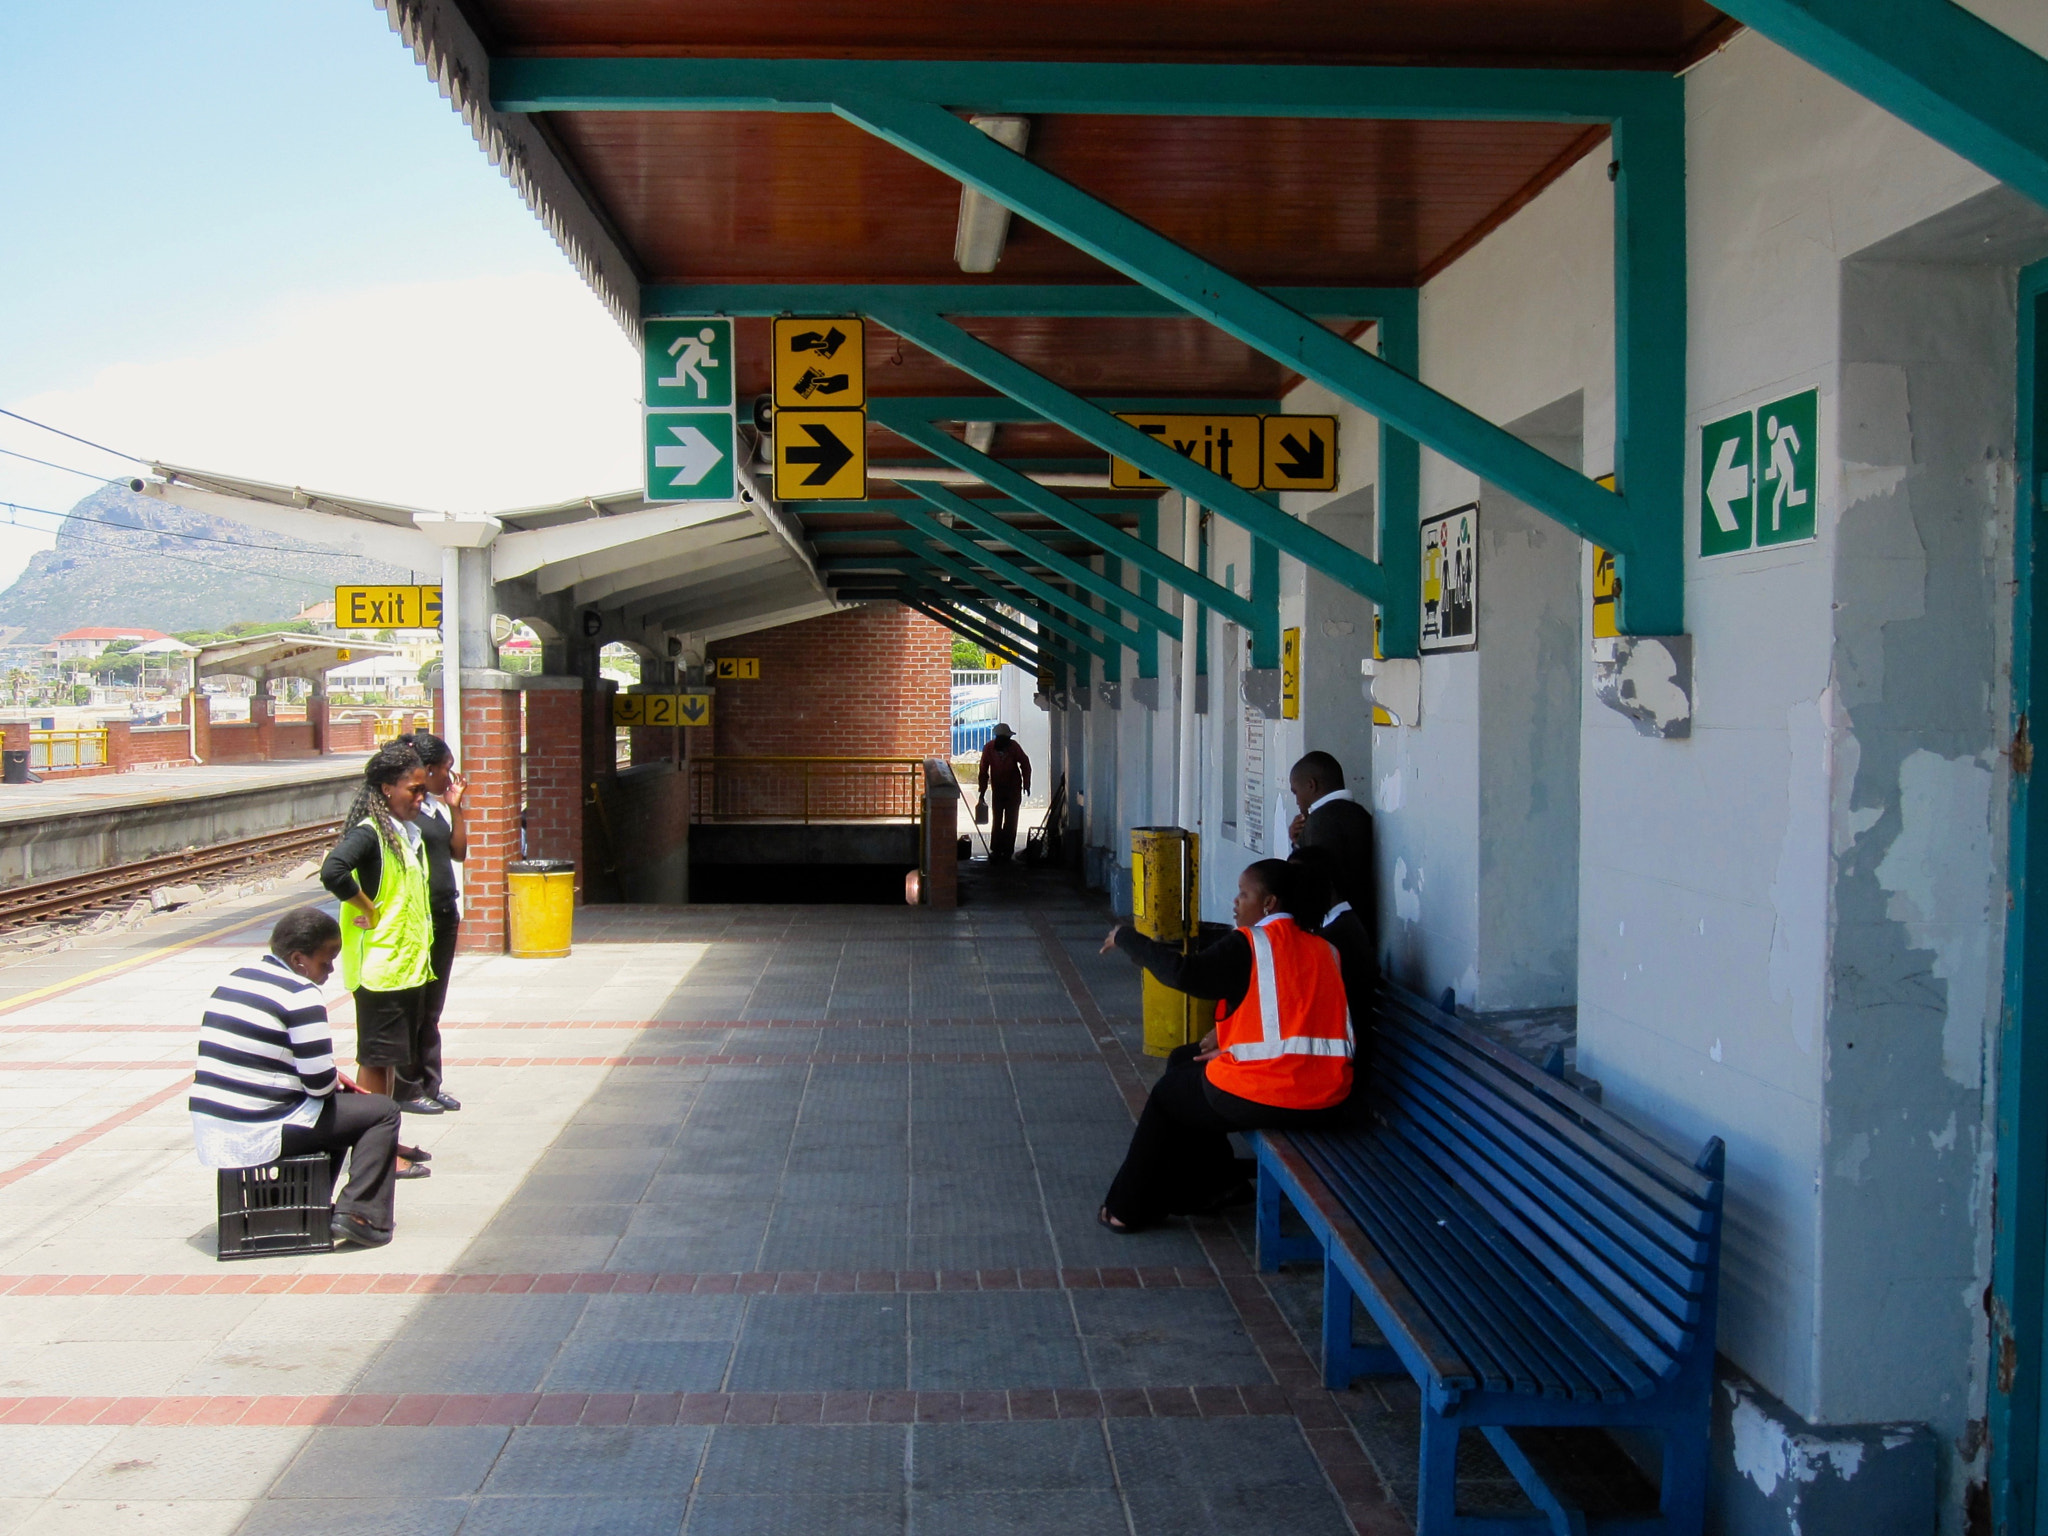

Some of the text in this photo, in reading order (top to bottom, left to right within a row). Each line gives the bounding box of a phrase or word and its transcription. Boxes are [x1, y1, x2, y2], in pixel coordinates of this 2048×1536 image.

[1138, 424, 1233, 481] it
[351, 592, 404, 623] Exit
[745, 661, 753, 676] 1
[653, 698, 670, 722] 2
